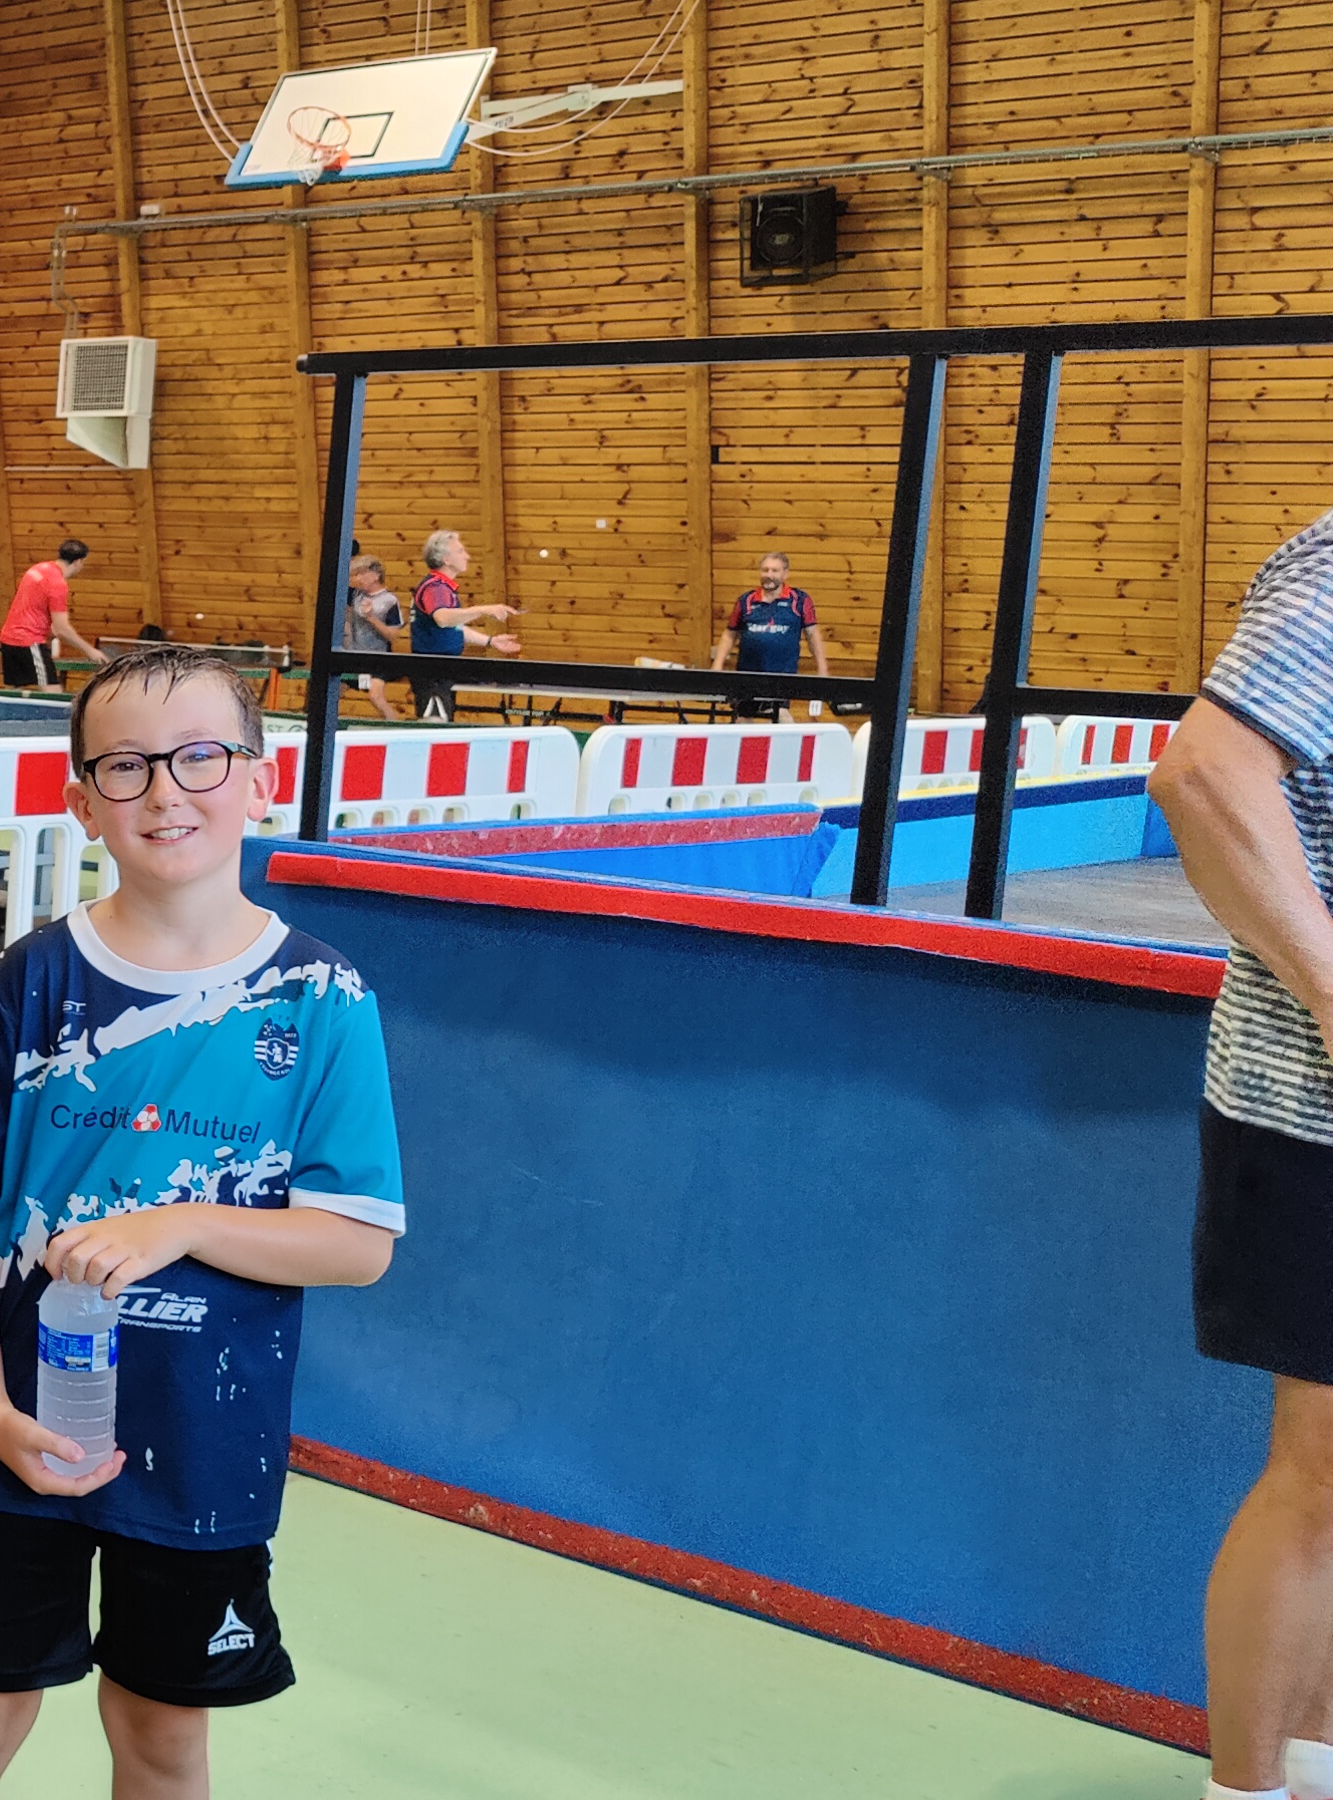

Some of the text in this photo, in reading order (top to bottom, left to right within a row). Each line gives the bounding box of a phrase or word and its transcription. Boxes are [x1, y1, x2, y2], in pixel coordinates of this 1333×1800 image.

[50, 1104, 261, 1143] Crédit Mutuel
[116, 1295, 208, 1323] LLIER
[207, 1633, 255, 1656] SELECT
